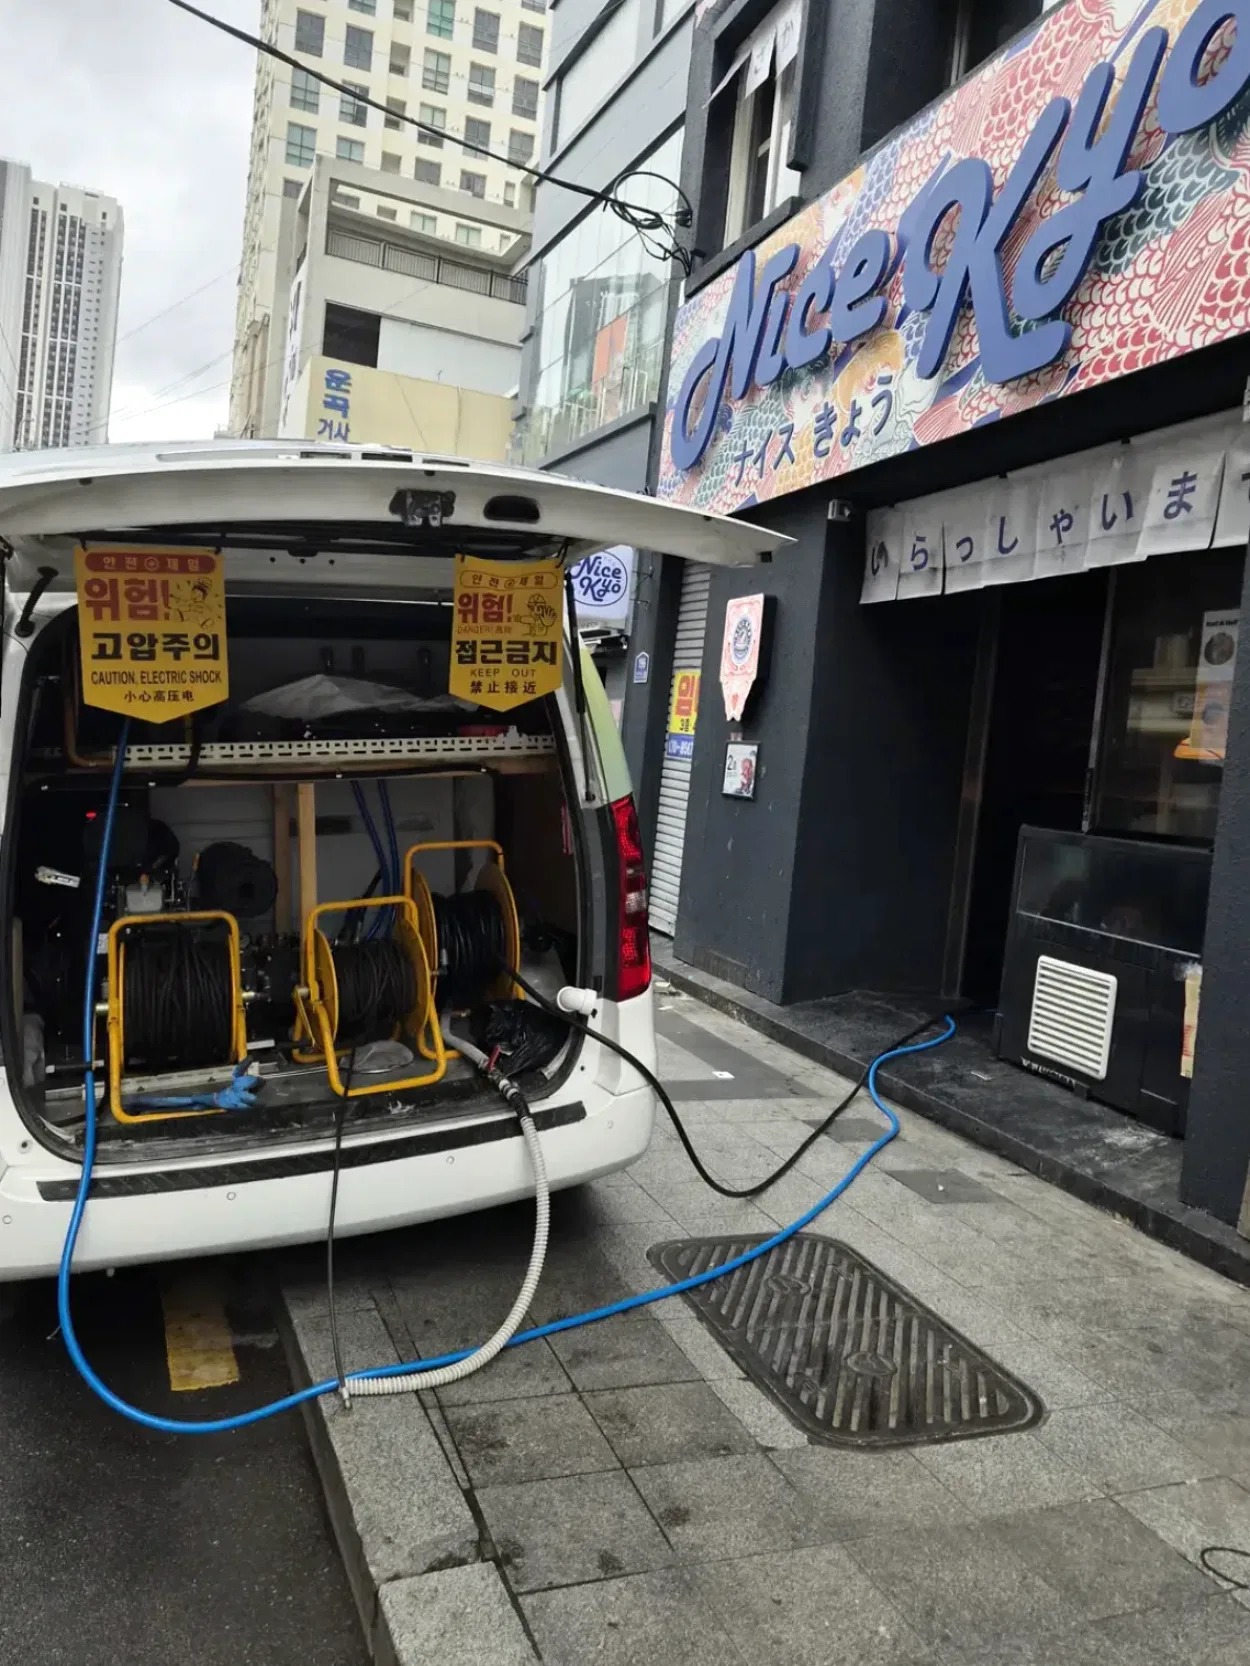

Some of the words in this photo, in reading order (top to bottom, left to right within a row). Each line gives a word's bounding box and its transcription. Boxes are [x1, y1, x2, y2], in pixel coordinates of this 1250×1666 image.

[670, 229, 893, 471] Nice
[733, 421, 796, 488] ナイス
[812, 374, 894, 458] きょう
[870, 471, 1250, 576] いらっしゃいま
[471, 573, 500, 588] 안전
[571, 556, 622, 579] Nice
[84, 577, 170, 622] 위험!
[457, 592, 513, 624] 위험!
[91, 632, 220, 662] 고압주의
[455, 640, 558, 666] 접근금지
[140, 670, 187, 685] ELECTRIC
[189, 670, 222, 684] SHOCK
[470, 668, 500, 678] KEEP
[511, 668, 536, 678] OUT
[124, 690, 195, 703] 小心高压电
[470, 680, 537, 695] 禁止接近
